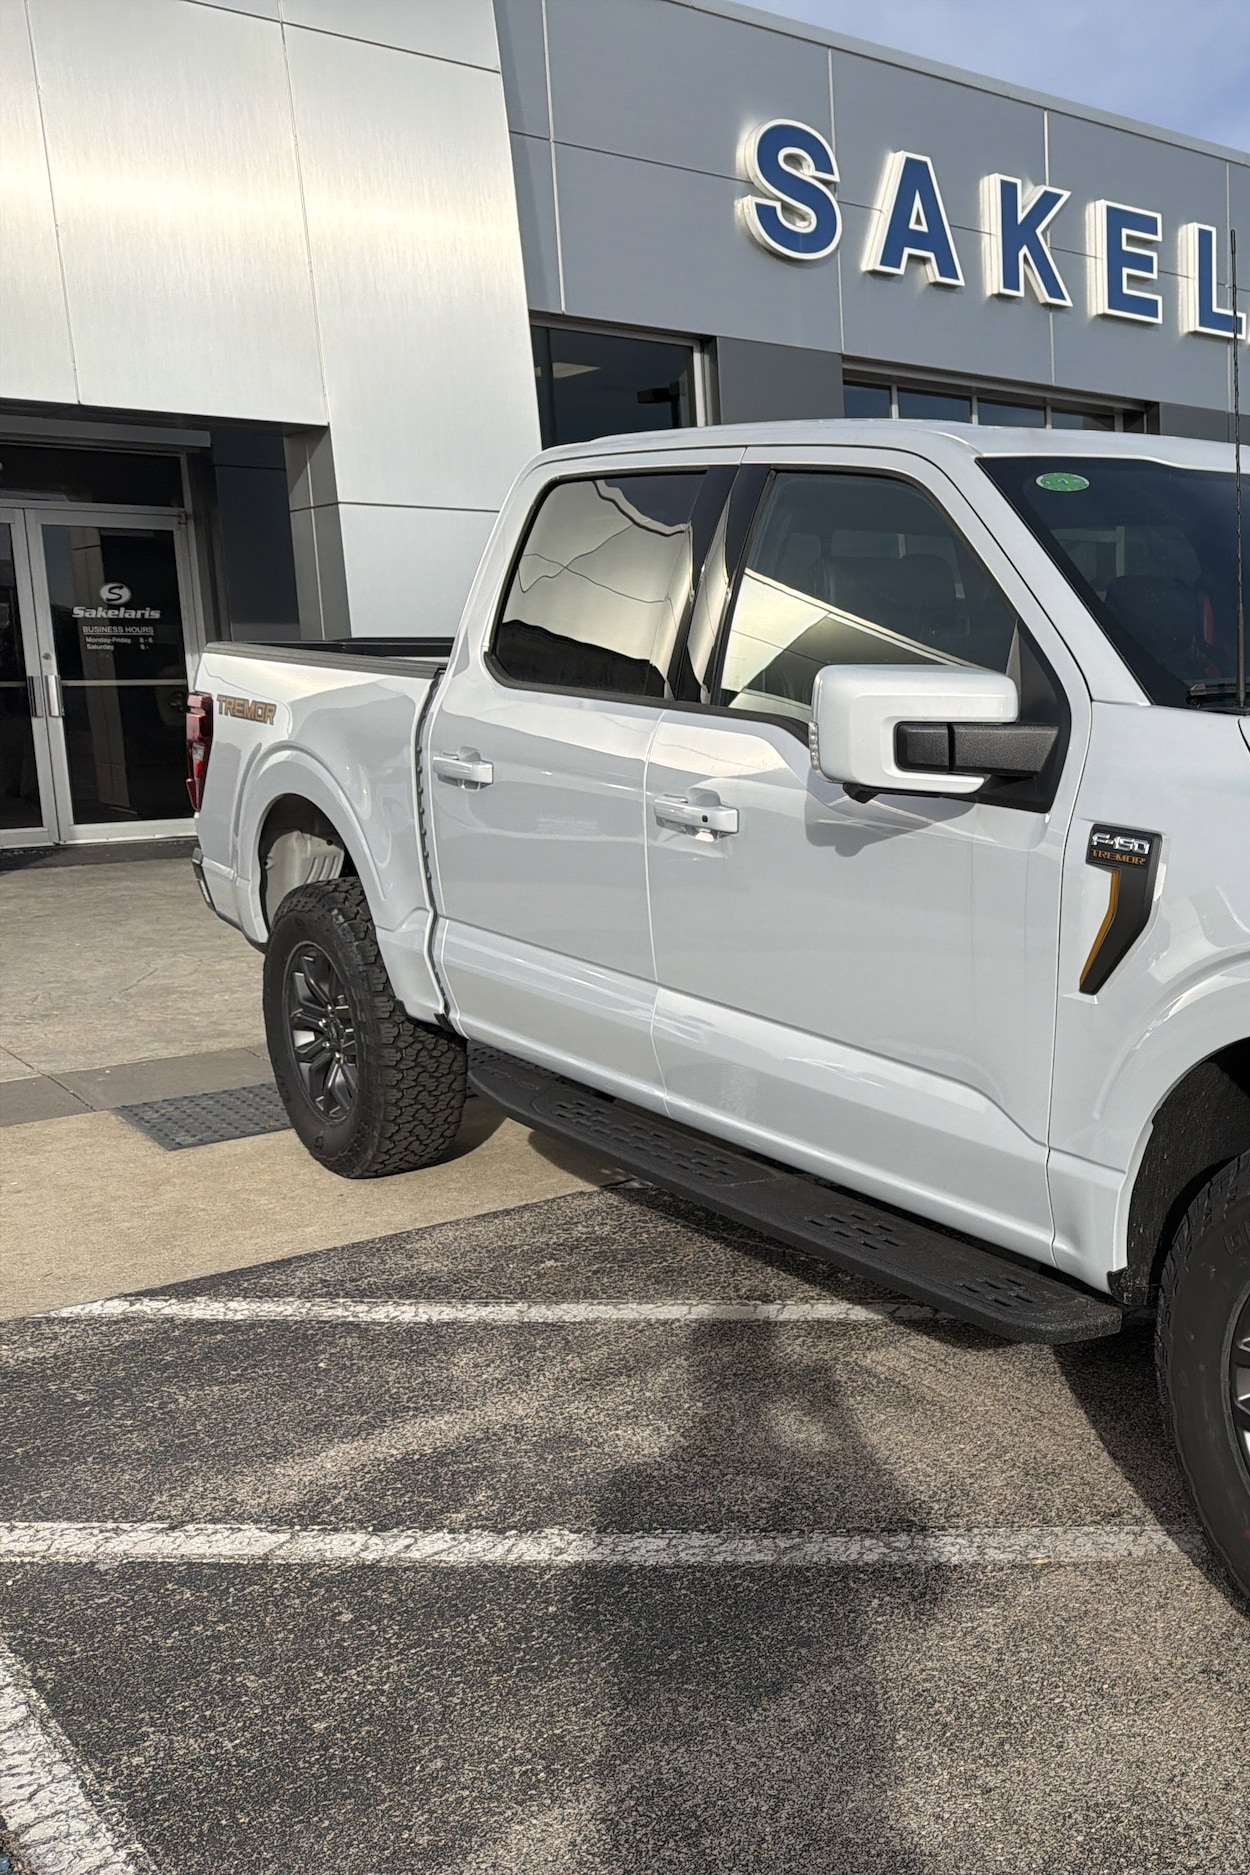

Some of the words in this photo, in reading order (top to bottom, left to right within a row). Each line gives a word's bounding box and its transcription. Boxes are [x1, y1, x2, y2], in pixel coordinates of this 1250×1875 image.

[72, 606, 160, 619] Sakelaris
[125, 626, 153, 634] HOURS
[217, 693, 277, 726] TREMOR
[1092, 832, 1150, 855] F-150
[1091, 849, 1147, 866] TREMOR
